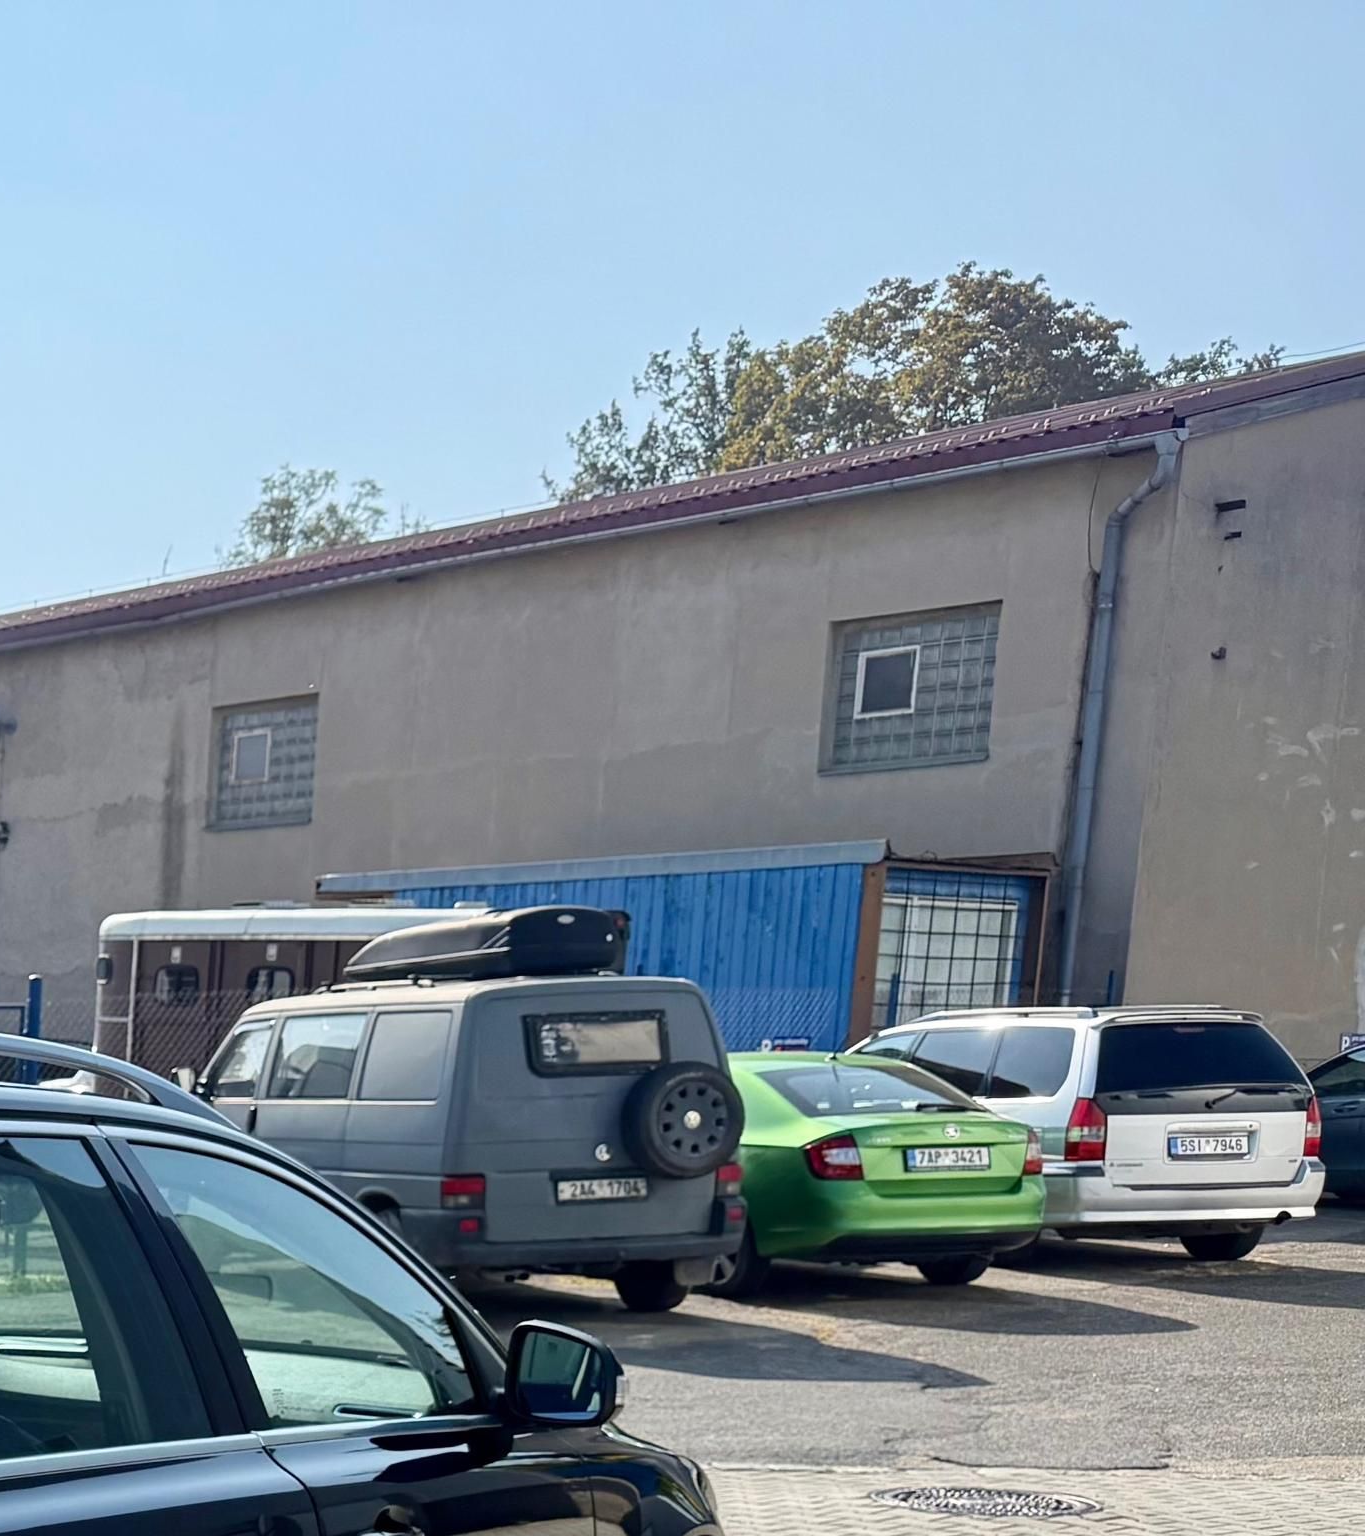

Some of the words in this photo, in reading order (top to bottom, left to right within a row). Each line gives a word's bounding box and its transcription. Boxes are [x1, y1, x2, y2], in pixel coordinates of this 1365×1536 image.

[1180, 1139, 1201, 1152] 5SI
[1213, 1139, 1243, 1152] 7946
[918, 1150, 942, 1164] 7AP
[952, 1149, 983, 1164] 3421
[607, 1181, 641, 1196] 1704
